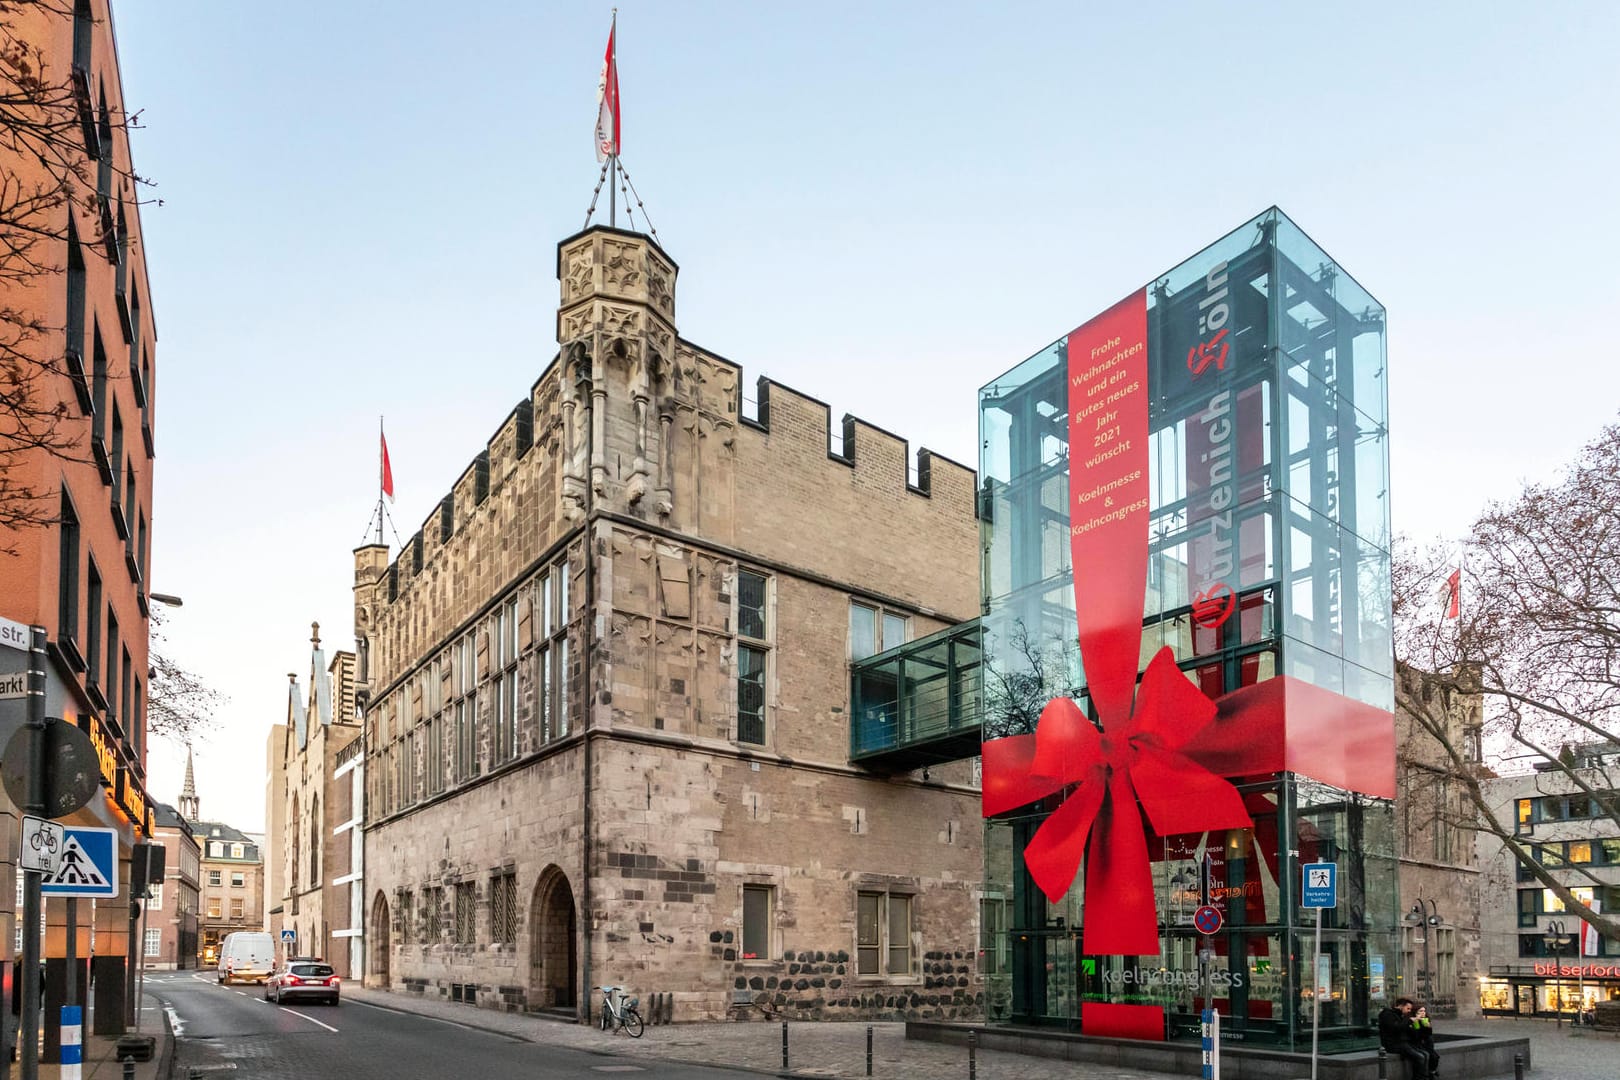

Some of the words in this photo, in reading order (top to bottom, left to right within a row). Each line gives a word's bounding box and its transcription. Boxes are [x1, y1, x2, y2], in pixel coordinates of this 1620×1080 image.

[1091, 336, 1120, 360] Frohe
[1072, 342, 1142, 387] Weihnachten
[1087, 377, 1107, 397] und
[1109, 369, 1126, 385] ein
[1076, 400, 1104, 423] gutes
[1107, 381, 1139, 404] neues
[1096, 410, 1118, 431] Jahr
[1094, 425, 1120, 447] 2021
[1085, 440, 1131, 469] wünscht
[1078, 470, 1141, 504] Koelnmesse
[1104, 496, 1113, 507] &
[1071, 498, 1148, 536] Koelncongress
[0, 626, 25, 644] str.
